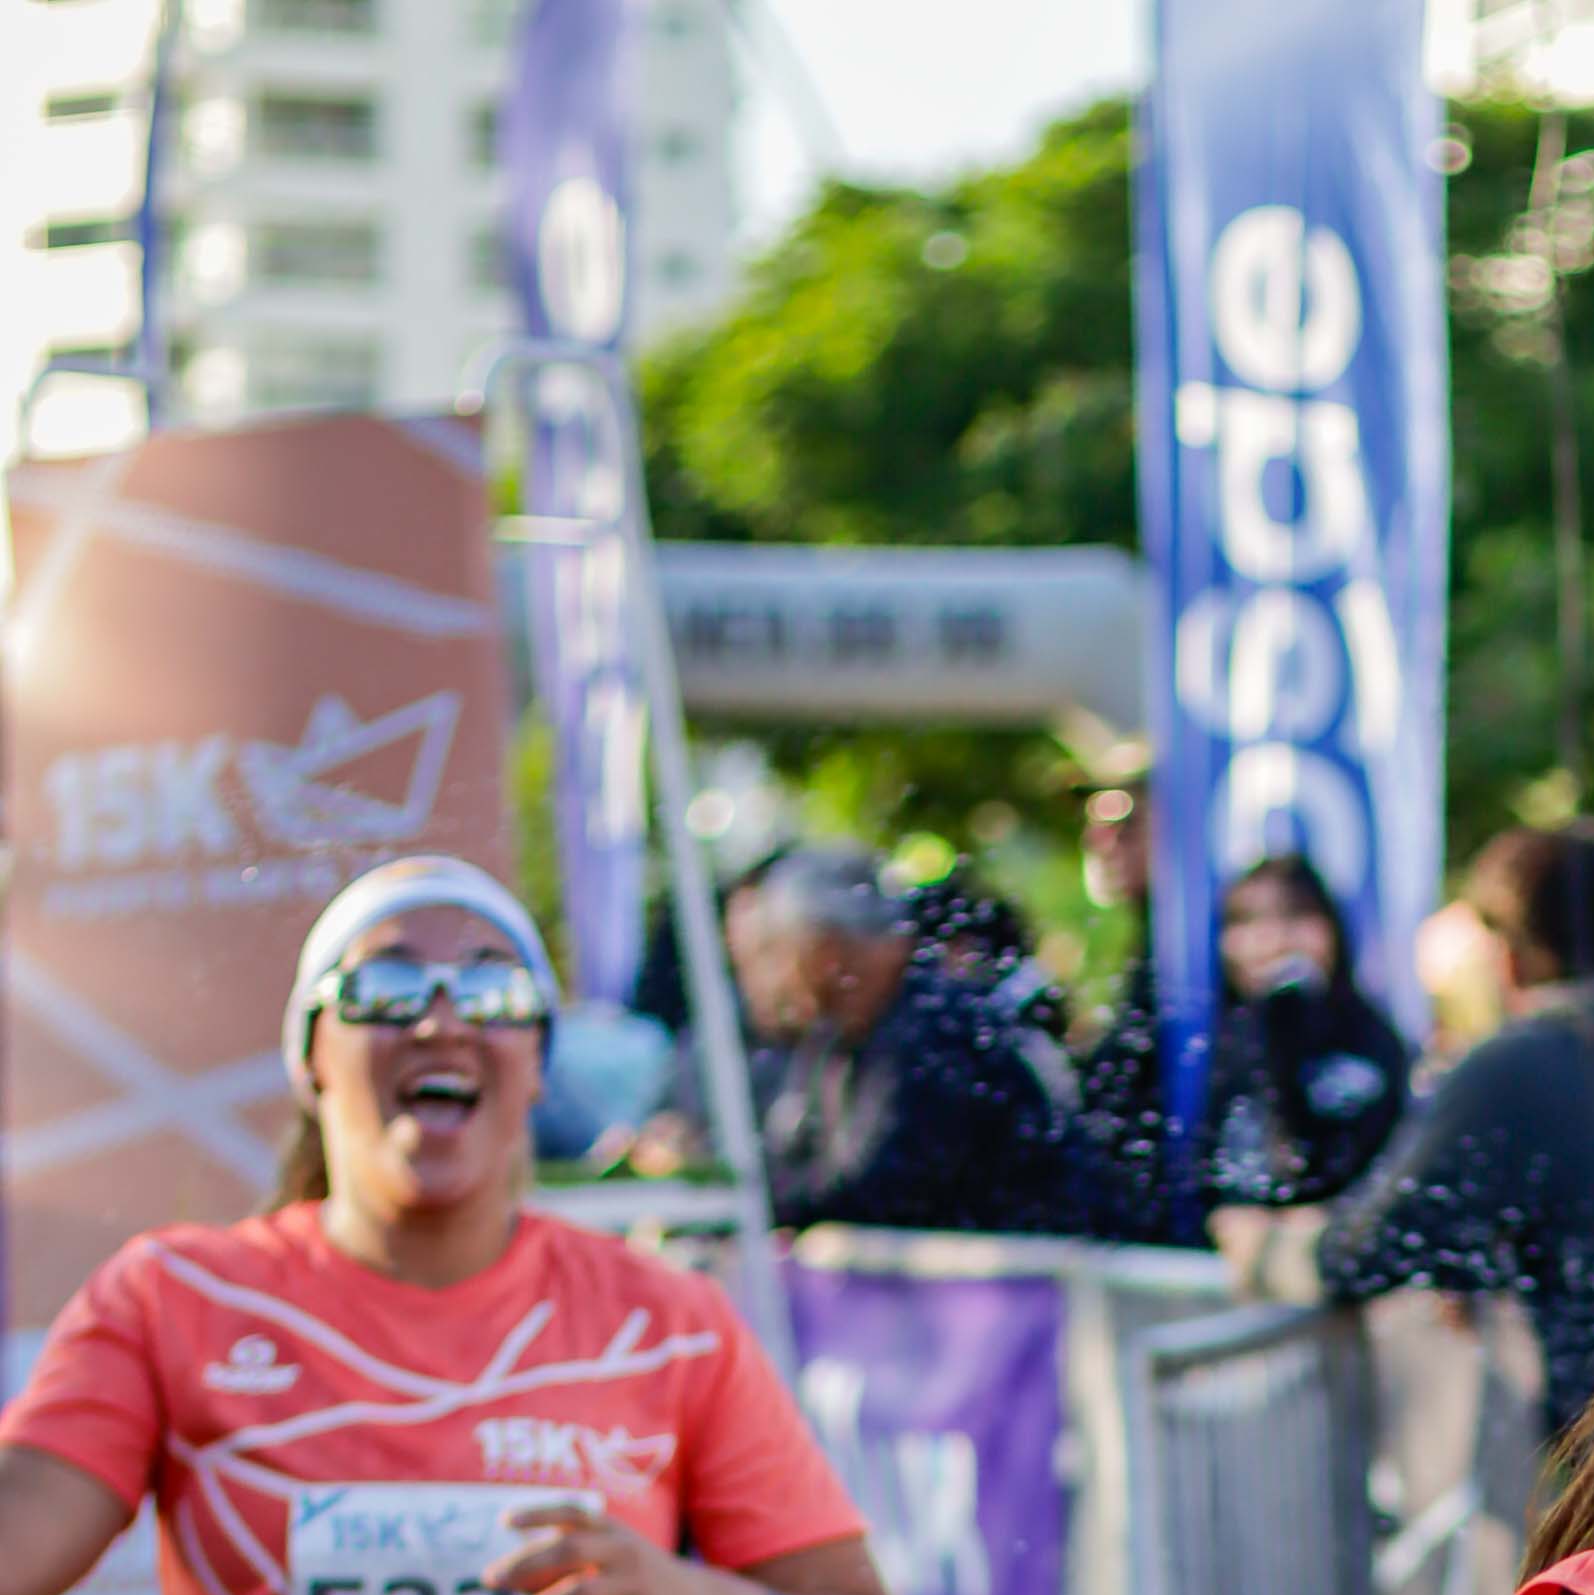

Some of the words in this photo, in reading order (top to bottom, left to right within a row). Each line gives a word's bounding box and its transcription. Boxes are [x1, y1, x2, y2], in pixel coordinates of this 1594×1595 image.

[44, 734, 236, 871] 15K
[475, 1417, 580, 1472] 15K
[331, 1513, 407, 1551] 15K
